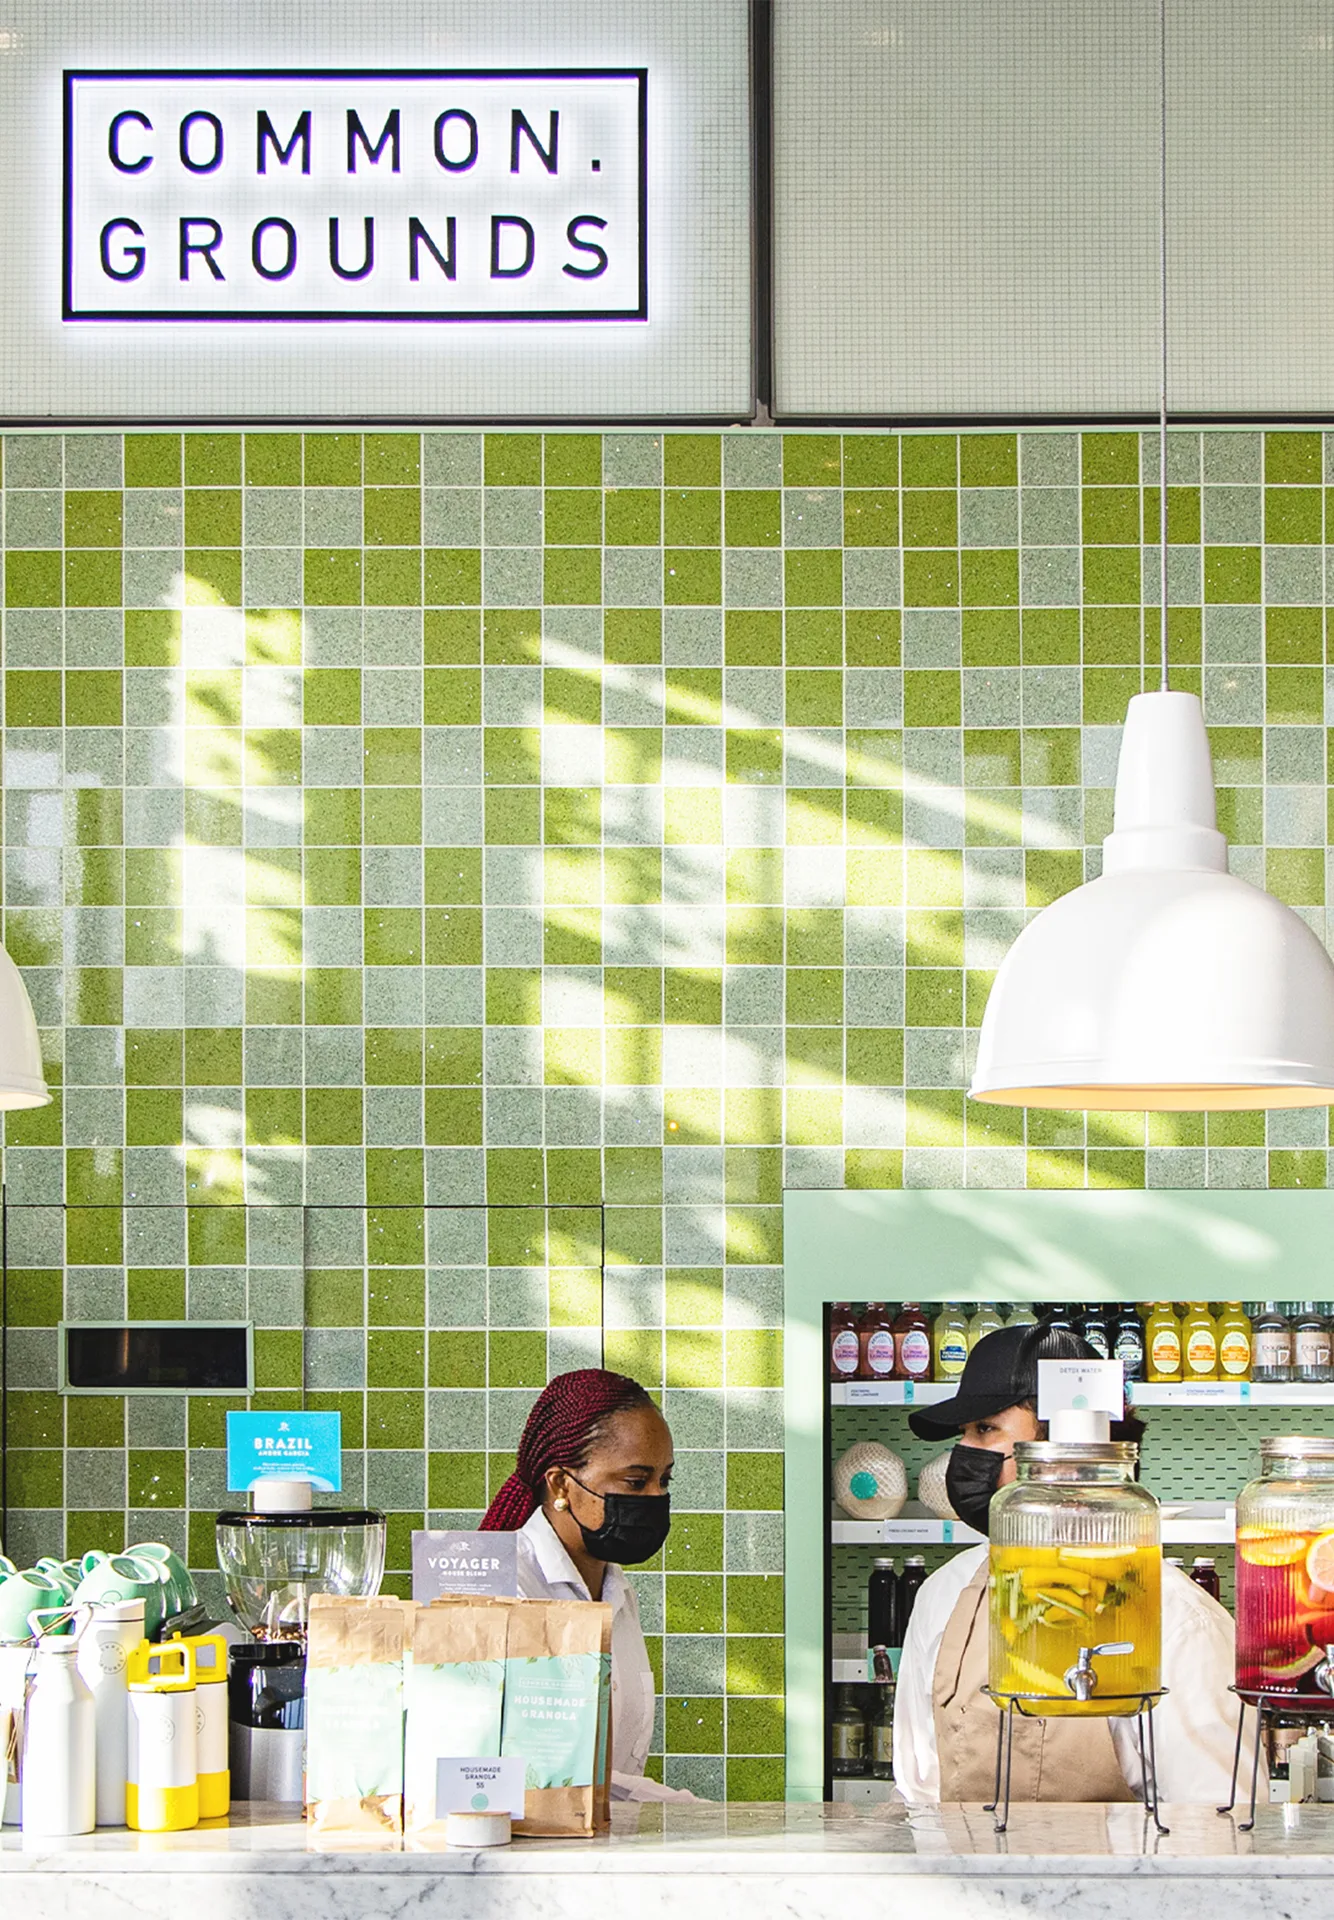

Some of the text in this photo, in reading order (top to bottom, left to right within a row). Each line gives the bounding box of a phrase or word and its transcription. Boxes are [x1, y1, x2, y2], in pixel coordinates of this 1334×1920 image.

[108, 109, 601, 175] COMMON.
[100, 214, 609, 282] GROUNDS
[254, 1437, 313, 1449] BRAZIL
[428, 1557, 501, 1570] VOYAGER
[514, 1695, 586, 1708] HOUSEMADE
[521, 1709, 577, 1721] GRANOLA
